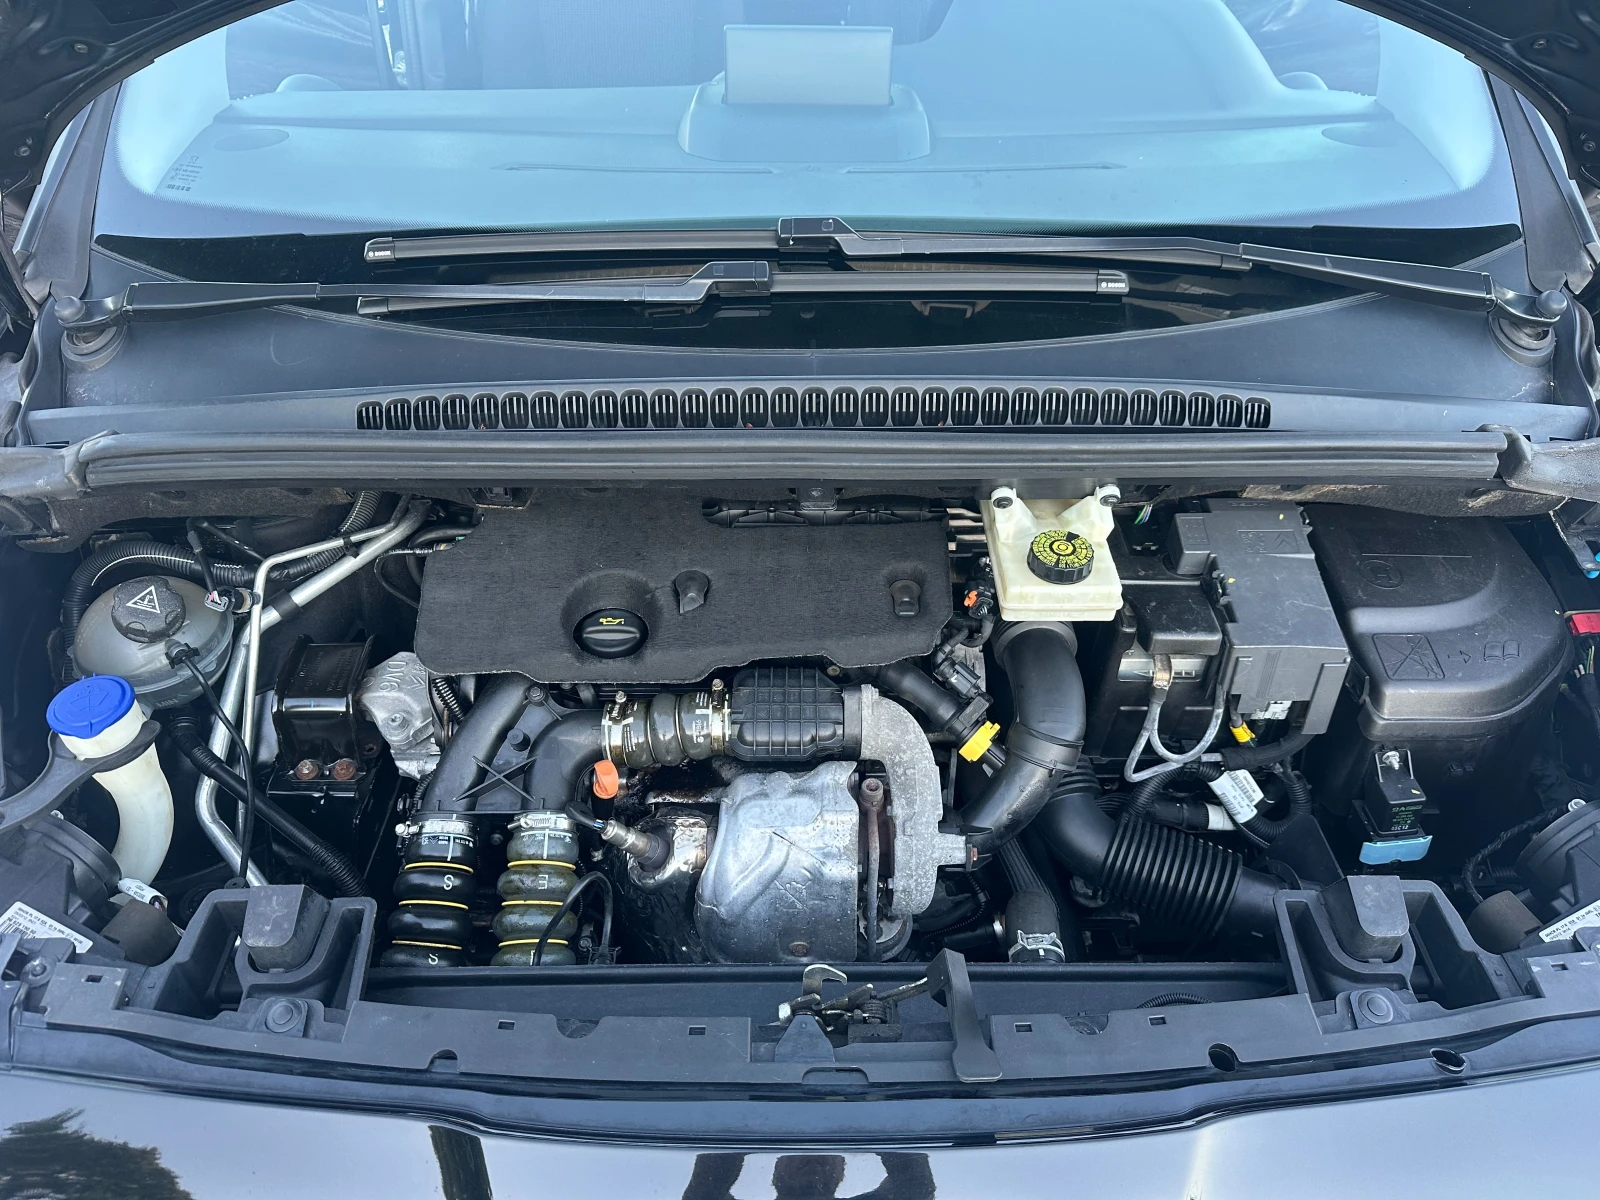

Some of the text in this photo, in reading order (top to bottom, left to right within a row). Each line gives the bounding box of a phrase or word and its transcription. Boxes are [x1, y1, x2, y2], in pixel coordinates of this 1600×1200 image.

[379, 661, 407, 692] DV6
[443, 874, 454, 891] S
[537, 874, 549, 890] E
